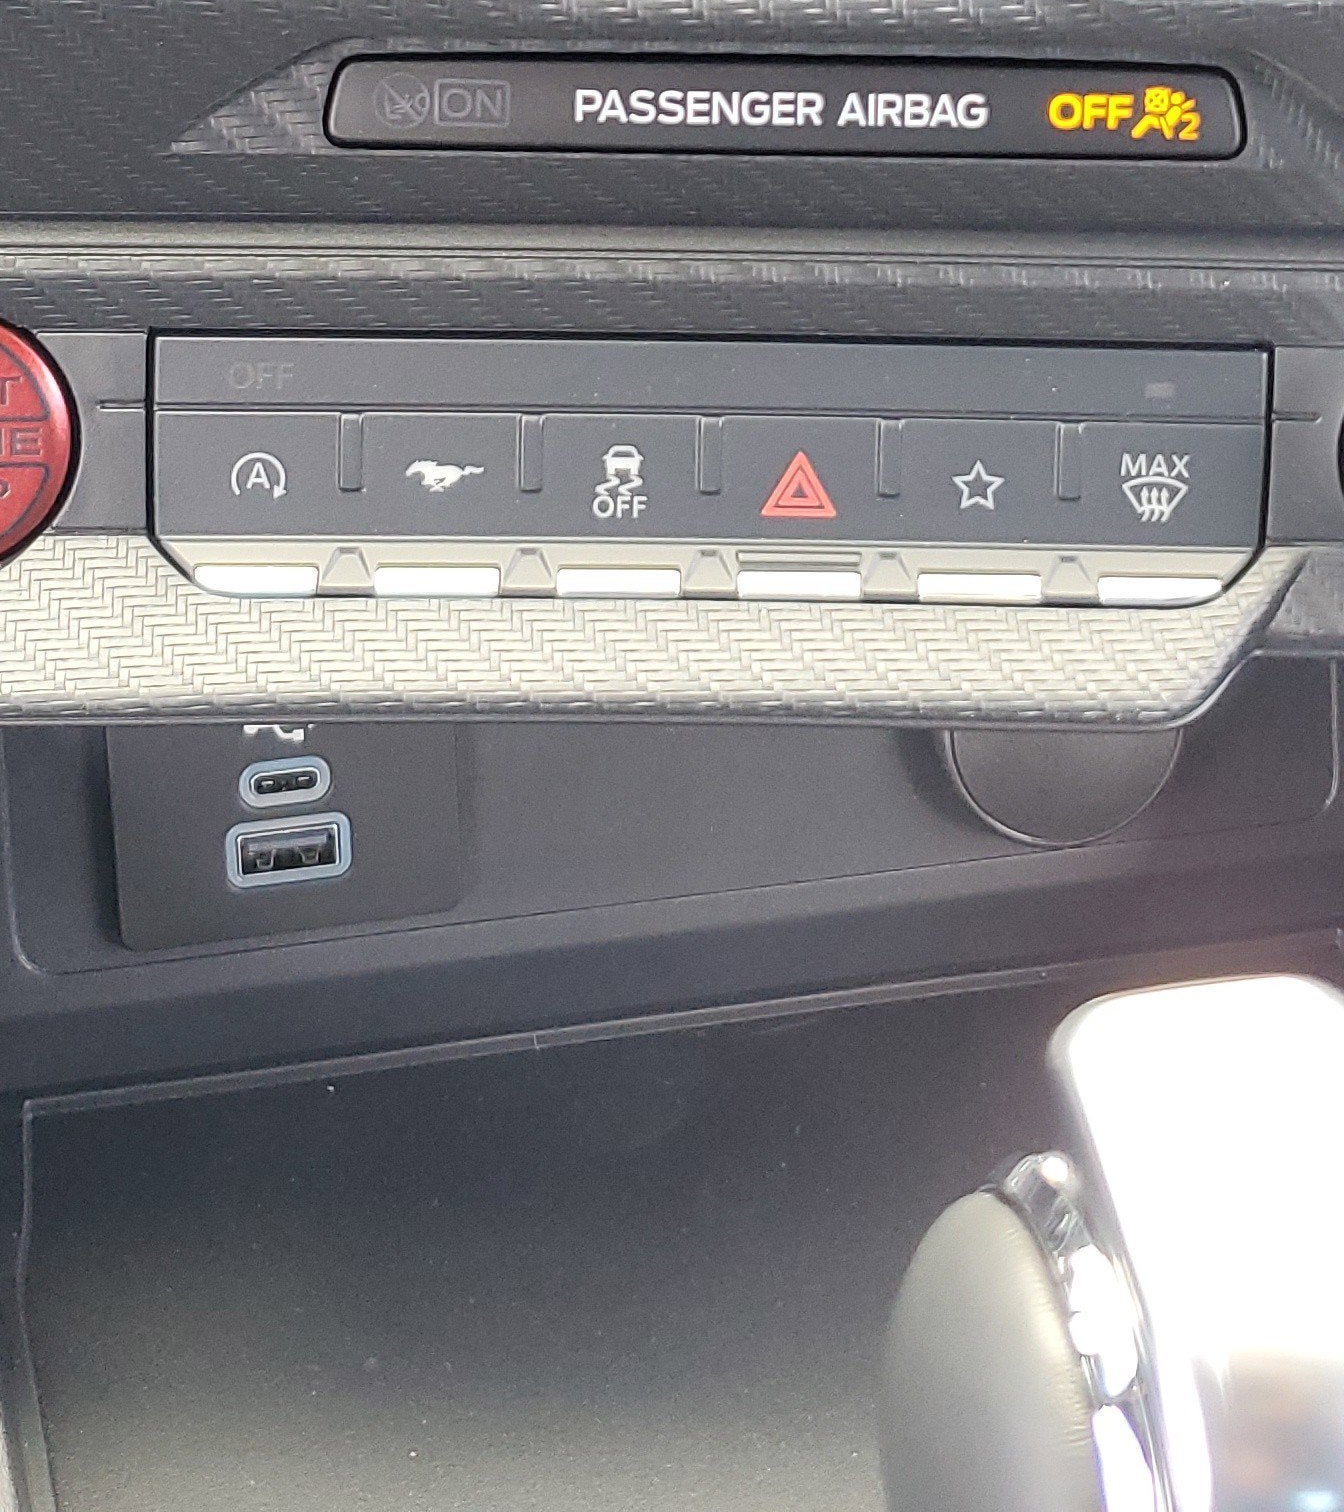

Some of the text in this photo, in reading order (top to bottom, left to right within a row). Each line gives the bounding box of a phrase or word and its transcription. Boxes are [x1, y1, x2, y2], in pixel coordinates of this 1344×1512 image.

[442, 88, 502, 118] ON
[574, 89, 989, 129] PASSENGER AIRBAG
[1048, 94, 1135, 130] OFF
[1120, 453, 1190, 478] MAX
[593, 494, 648, 519] OFF
